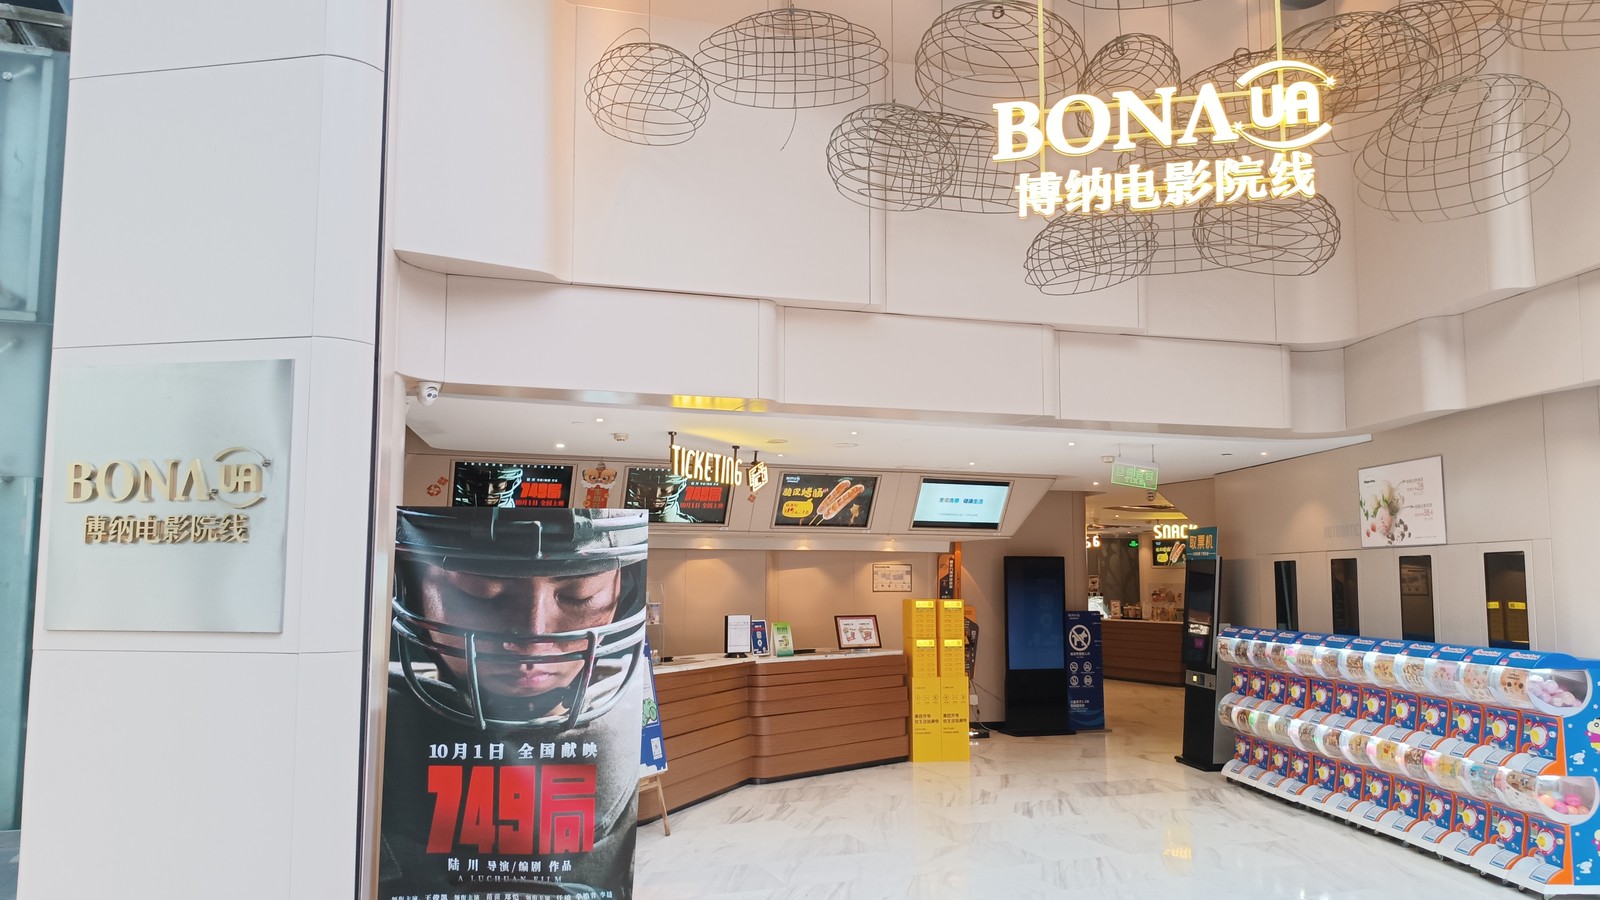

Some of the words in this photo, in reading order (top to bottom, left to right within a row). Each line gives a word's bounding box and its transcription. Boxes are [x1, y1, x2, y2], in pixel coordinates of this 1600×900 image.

[992, 82, 1238, 162] BONA
[1014, 152, 1317, 218] 博纳电影院线
[672, 444, 742, 486] TICKETING
[65, 459, 211, 503] BONA
[84, 514, 250, 545] 博纳电影院线
[1153, 524, 1198, 539] SNAC
[1189, 535, 1214, 549] 取票机
[428, 742, 505, 760] 10月1日
[517, 742, 599, 760] 全国献映
[426, 764, 597, 855] 749局
[470, 874, 527, 882] LUCHUAN
[487, 860, 542, 873] 导演/编剧
[548, 860, 572, 872] 作品
